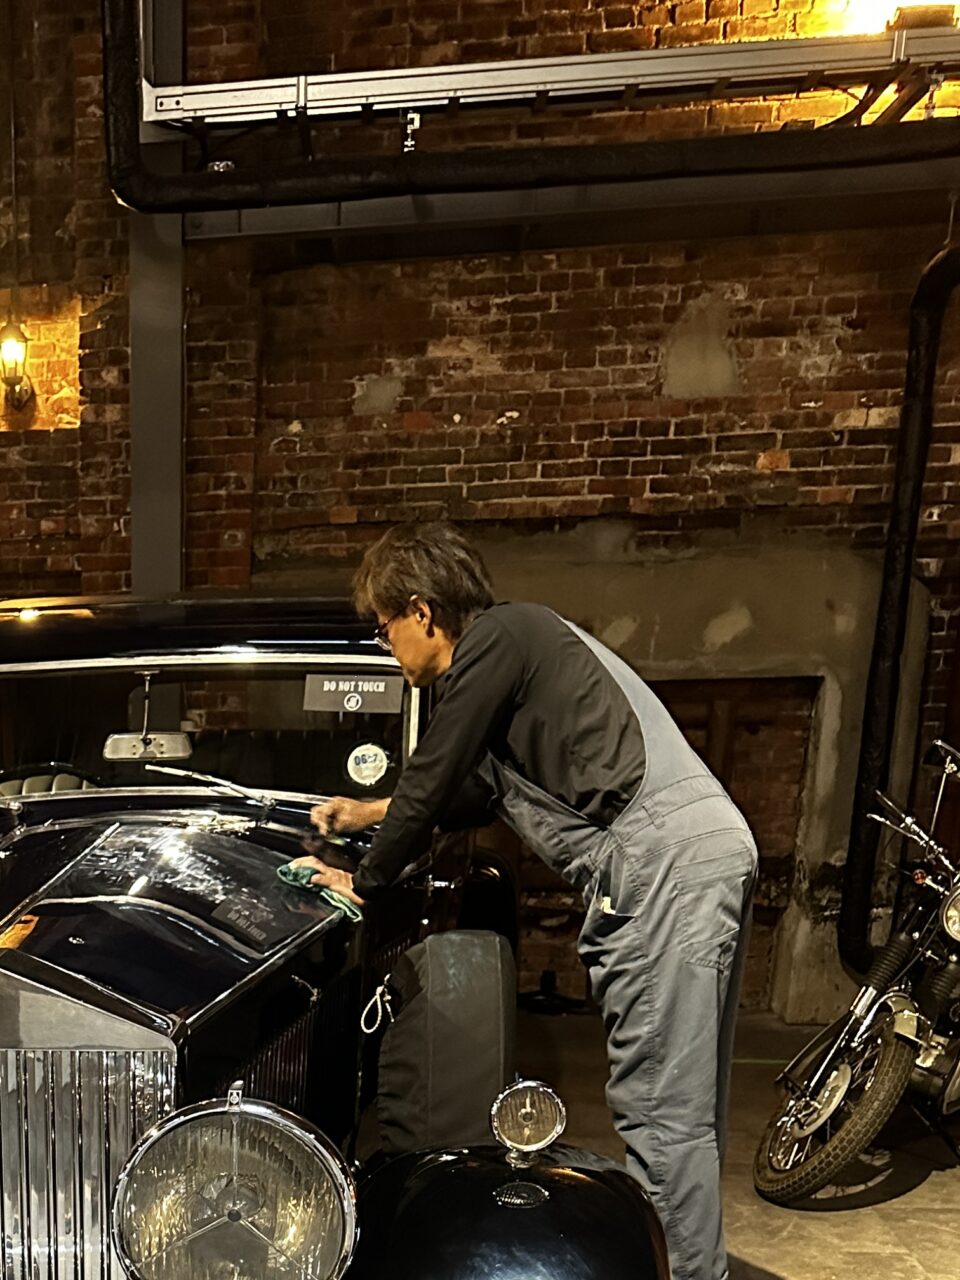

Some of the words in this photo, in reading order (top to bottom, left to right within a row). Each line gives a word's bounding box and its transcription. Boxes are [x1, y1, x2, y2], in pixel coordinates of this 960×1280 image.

[323, 681, 336, 691] DO
[338, 681, 356, 692] NOT
[358, 681, 386, 692] TOUCH
